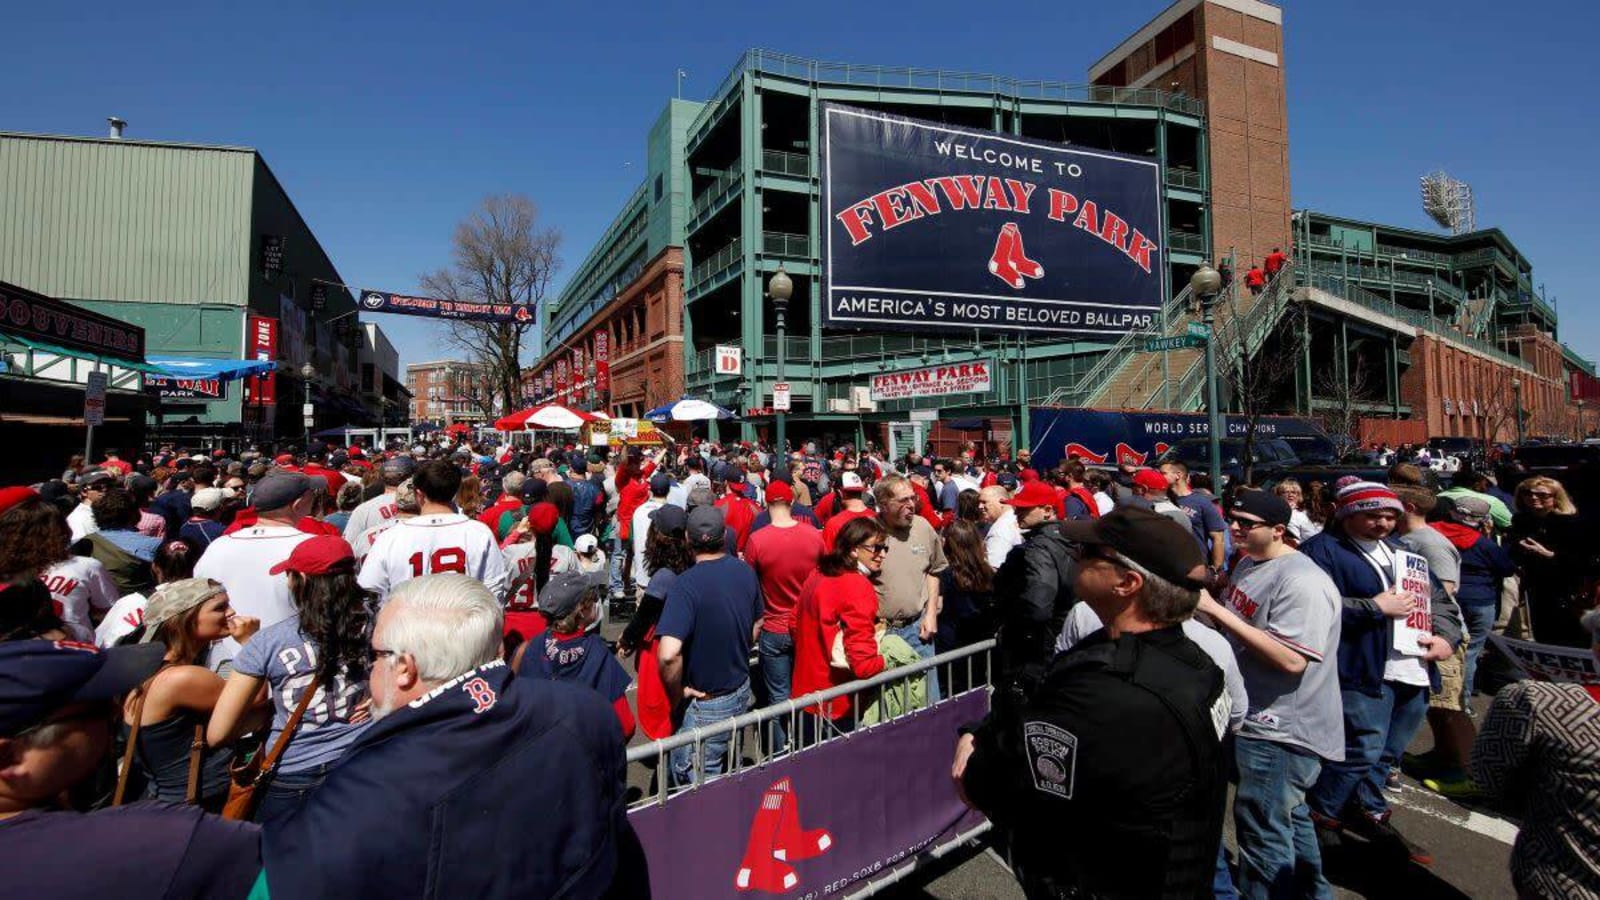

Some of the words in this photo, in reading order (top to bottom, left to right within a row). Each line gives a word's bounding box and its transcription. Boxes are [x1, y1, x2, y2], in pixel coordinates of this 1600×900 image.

[934, 140, 1043, 174] WELCOME
[1054, 161, 1083, 178] TO
[836, 174, 1036, 247] FENWAY
[1047, 186, 1158, 274] PARK
[390, 295, 438, 310] WELCOME
[440, 301, 453, 311] TO
[836, 297, 947, 318] AMERICA'S
[952, 303, 1001, 320] MOST
[1005, 307, 1081, 325] BELOVED
[1084, 311, 1153, 328] BALLPAR
[0, 294, 139, 352] OUVENIRS
[258, 320, 271, 347] ZONE
[1149, 336, 1186, 350] YAWKEY
[722, 355, 738, 372] D
[874, 369, 930, 388] FENWAY
[936, 361, 987, 381] PARK
[159, 390, 194, 398] PARK
[1145, 421, 1184, 434] WORLD
[1229, 422, 1277, 434] CHAPIONS
[1405, 554, 1428, 573] WEE
[462, 677, 498, 714] B
[1031, 736, 1070, 757] BOSTON
[1035, 744, 1067, 760] POLICE
